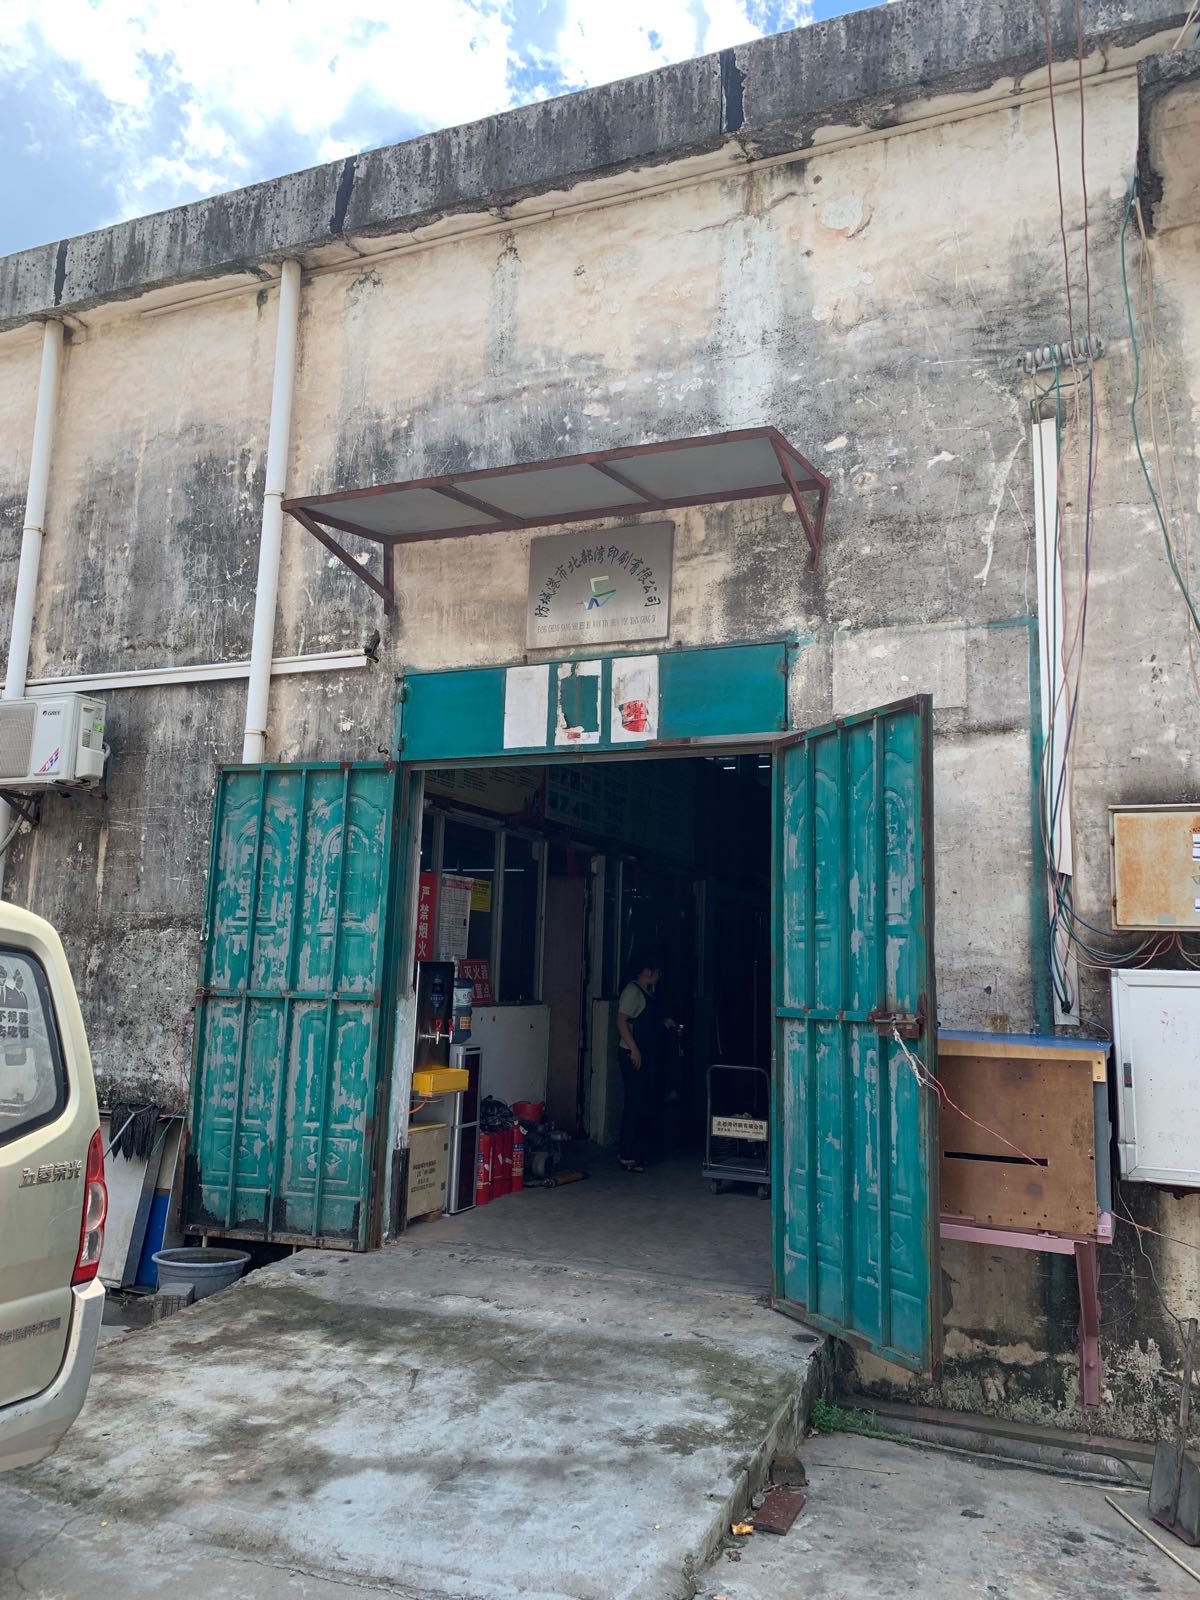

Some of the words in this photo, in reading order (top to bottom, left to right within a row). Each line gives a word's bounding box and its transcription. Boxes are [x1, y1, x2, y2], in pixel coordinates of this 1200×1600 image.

[534, 545, 662, 618] 防城港市北部湾印刷有限公司
[418, 886, 431, 958] 严禁烟火
[463, 964, 489, 980] 灭火器
[19, 1160, 82, 1188] 五菱荣光
